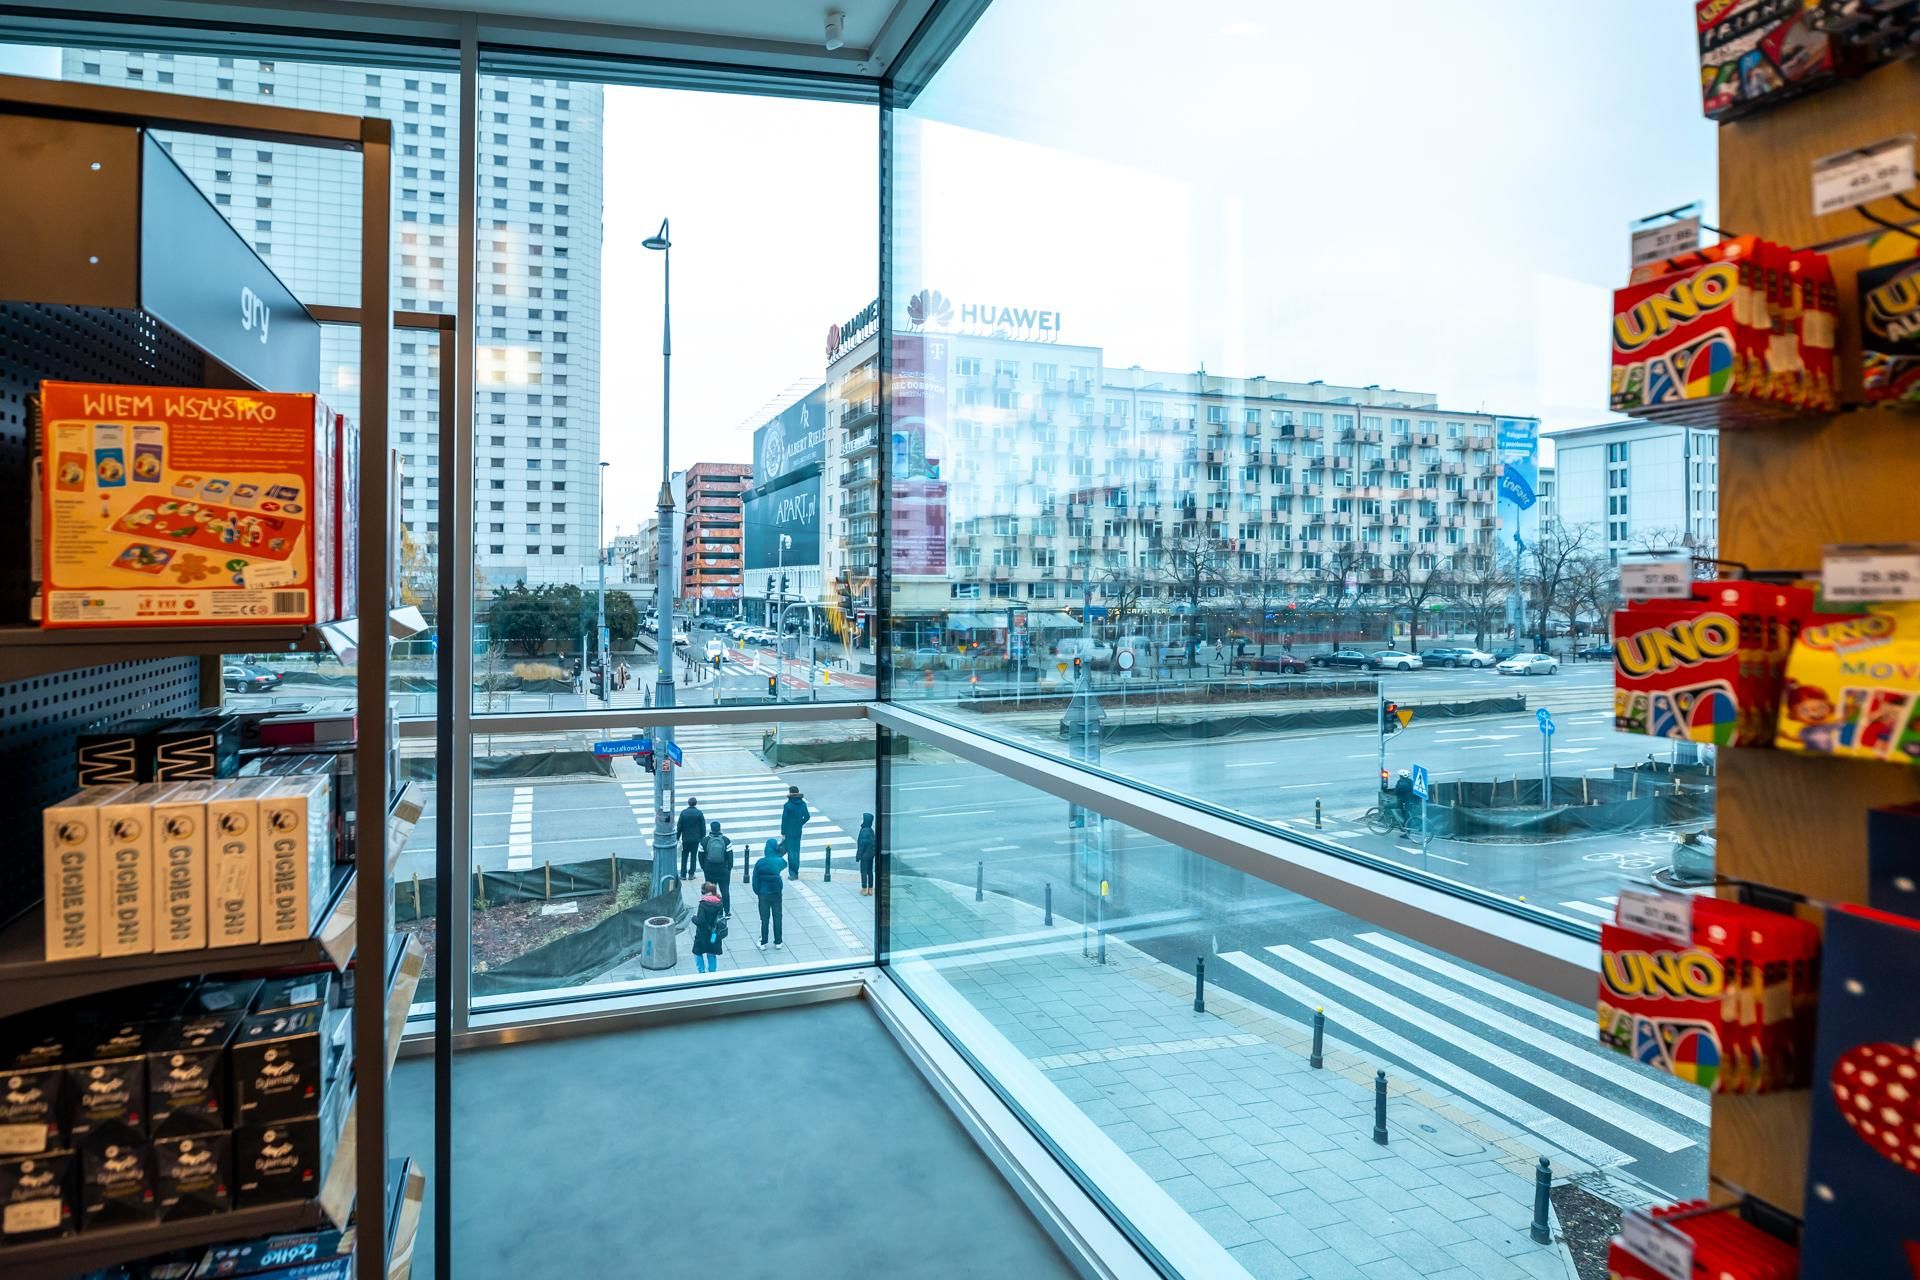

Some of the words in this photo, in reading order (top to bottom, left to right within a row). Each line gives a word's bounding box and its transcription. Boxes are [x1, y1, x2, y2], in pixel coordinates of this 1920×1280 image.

[241, 286, 270, 344] gry
[961, 303, 1061, 331] HUAWEI
[1614, 262, 1739, 352] UNO
[83, 393, 153, 417] WIEM
[776, 493, 816, 525] APART.pl
[1614, 612, 1740, 679] UNO
[1804, 614, 1890, 648] UNO
[1840, 661, 1920, 680] MOV
[273, 838, 297, 894] CICHE
[1601, 950, 1725, 1000] UNO
